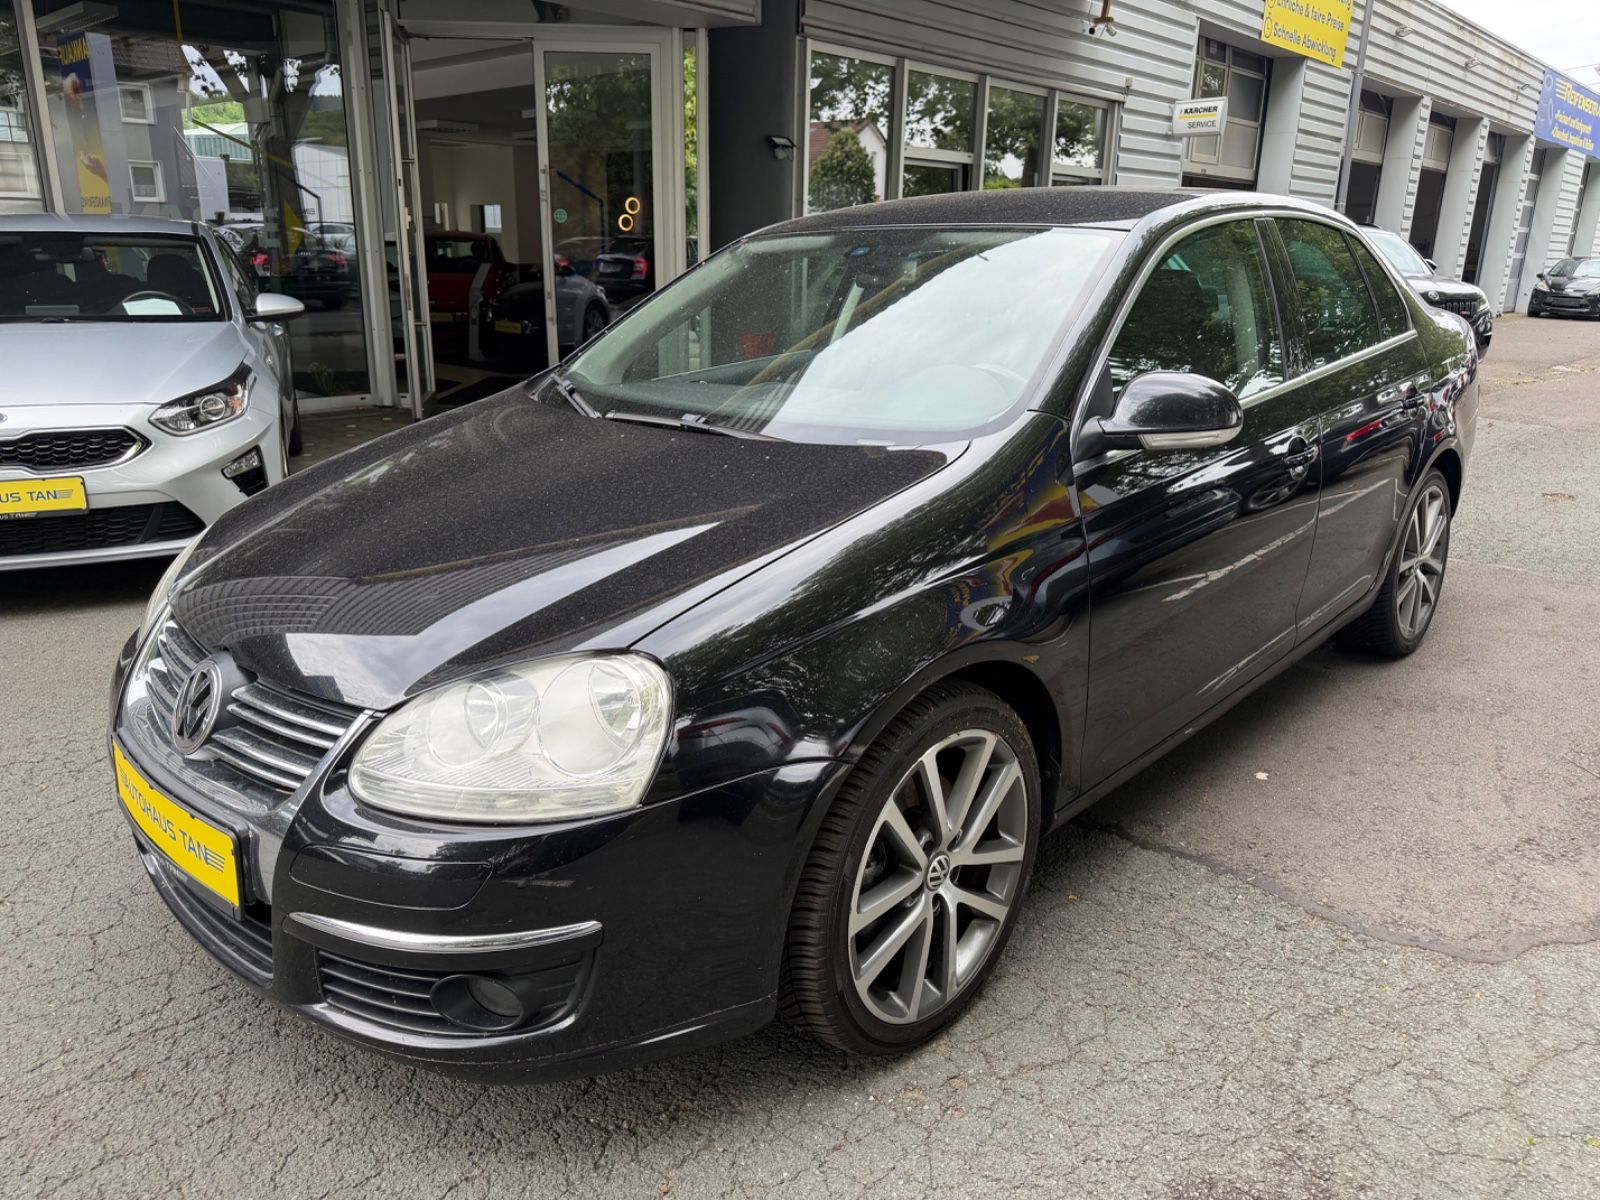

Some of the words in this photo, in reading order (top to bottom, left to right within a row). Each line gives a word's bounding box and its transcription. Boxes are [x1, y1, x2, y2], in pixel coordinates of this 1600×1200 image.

[1327, 12, 1344, 31] Preise
[1273, 22, 1301, 45] Schnelle
[1302, 33, 1337, 62] Abwicklung
[1187, 119, 1217, 128] SERVICE
[26, 489, 58, 502] TAN
[126, 781, 177, 841] AUTOHAUS
[179, 829, 209, 865] TAN
